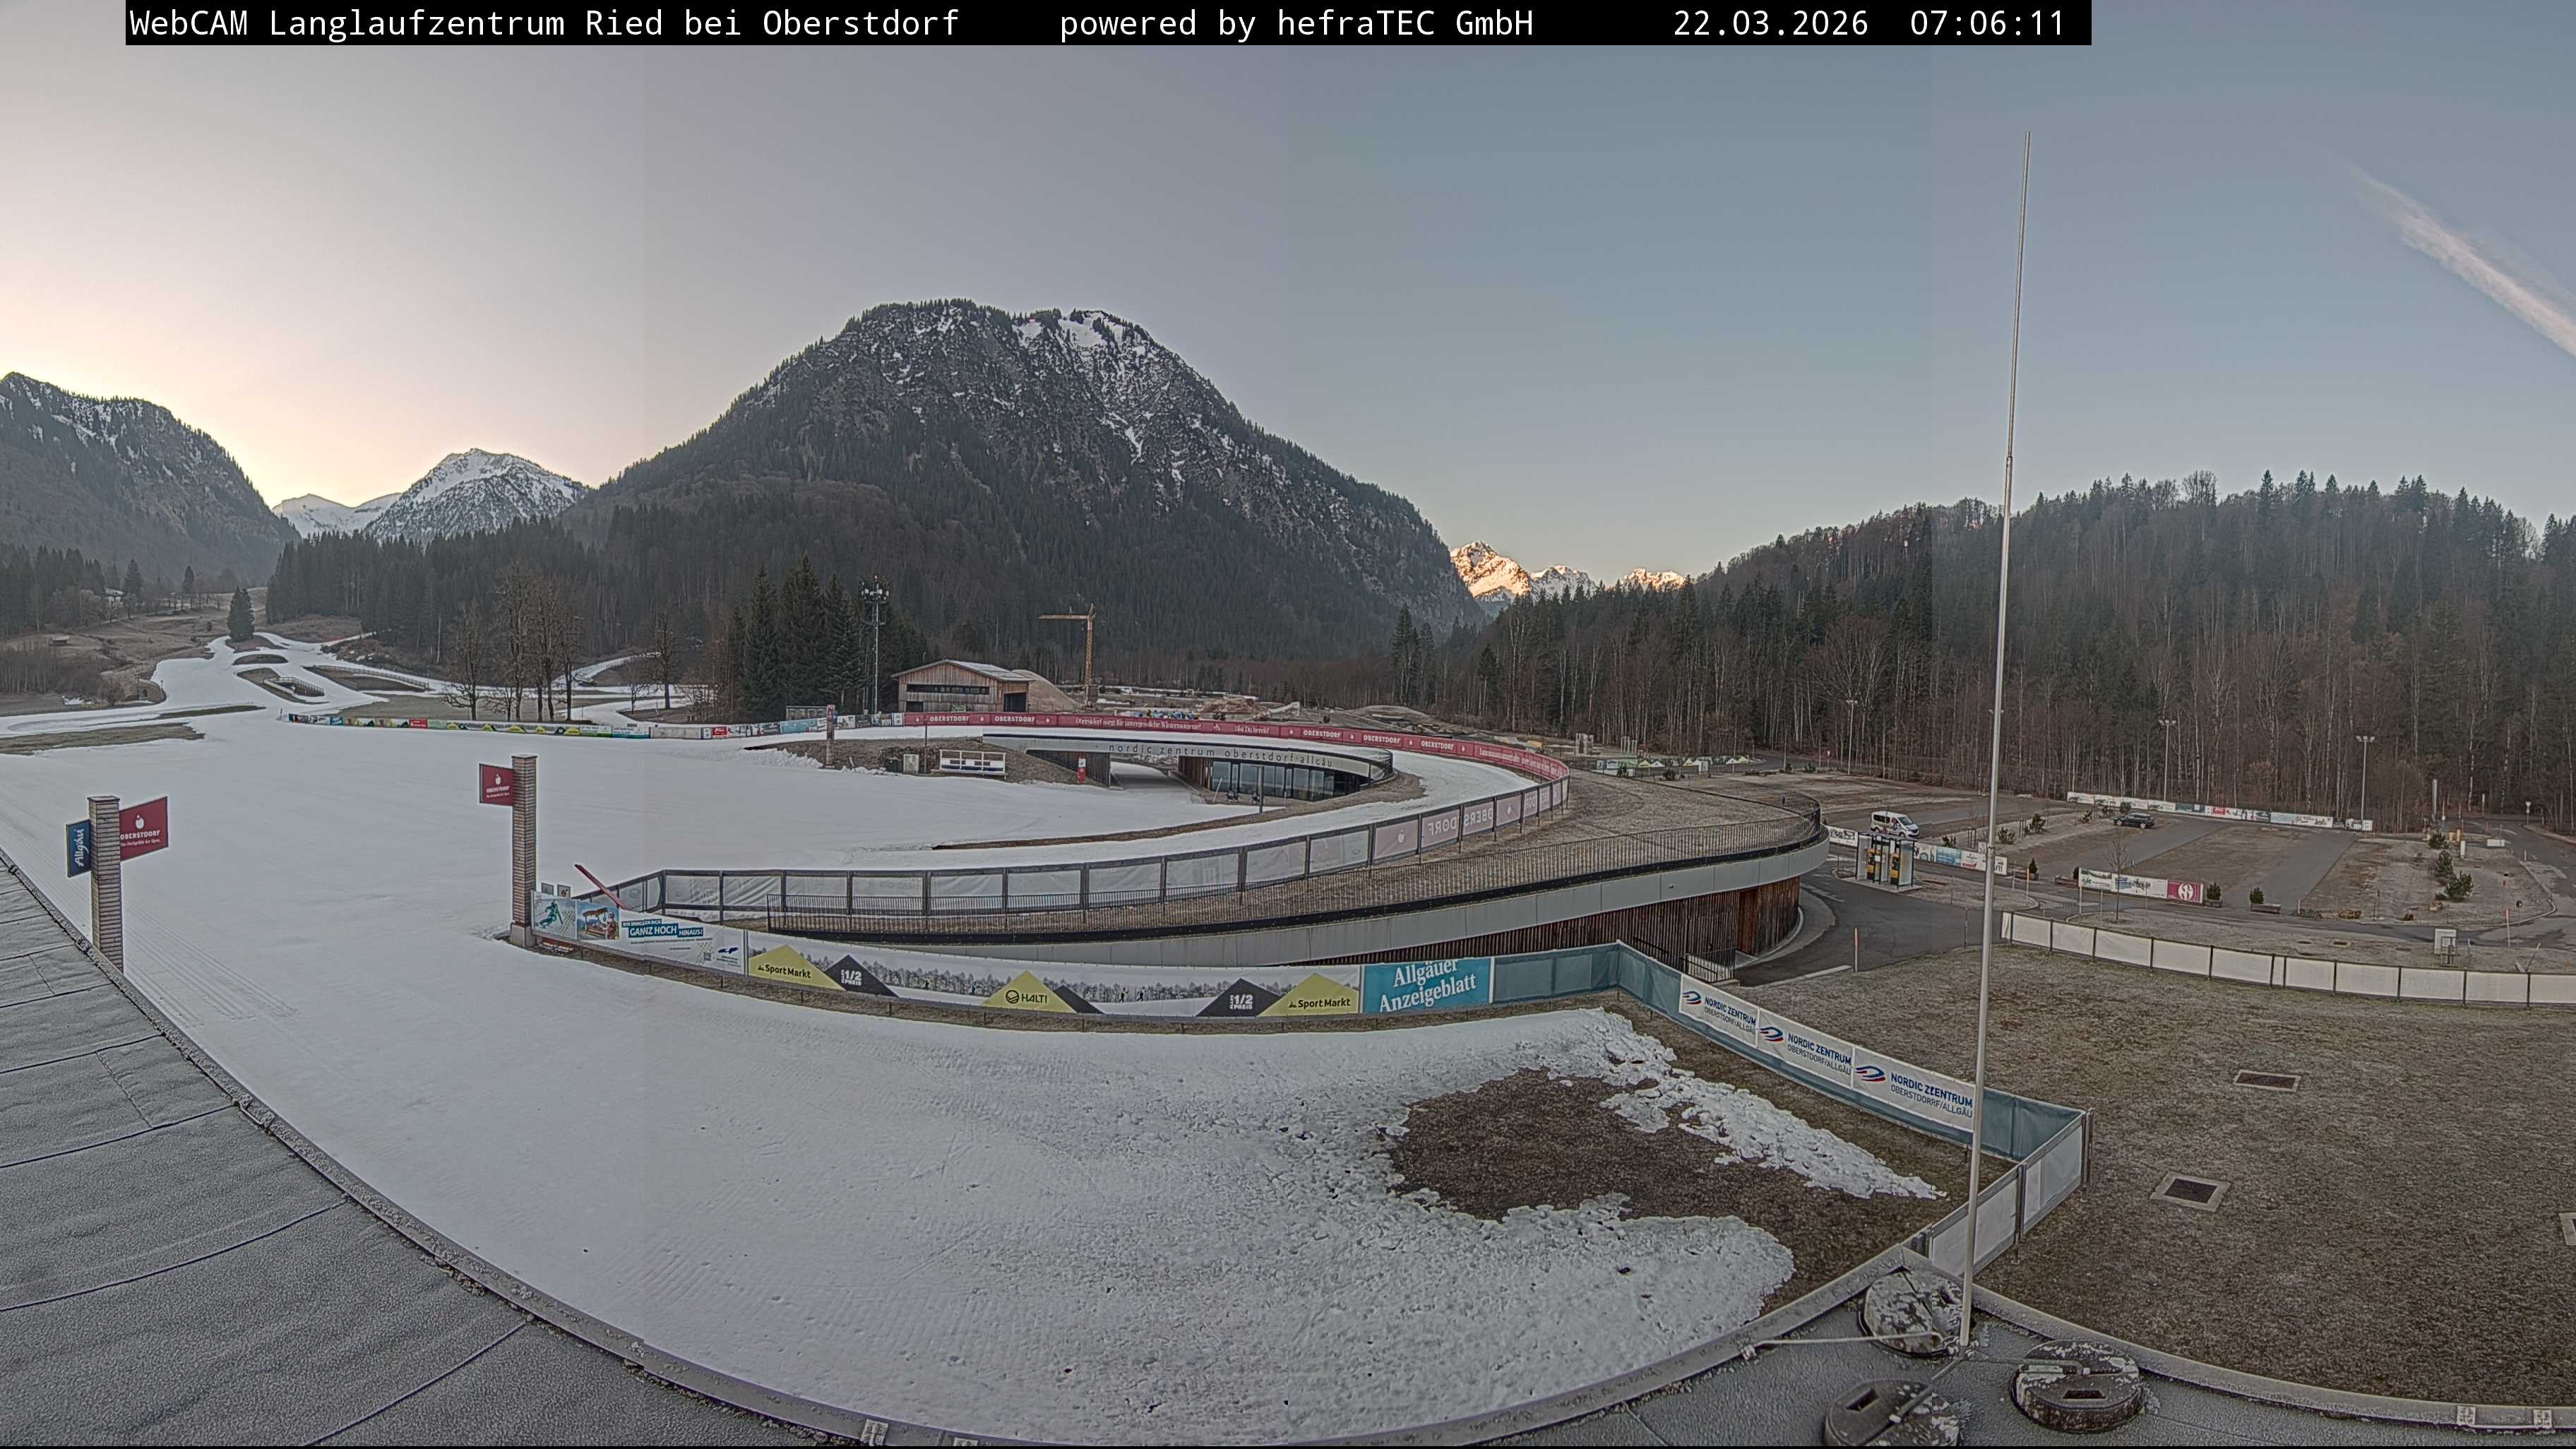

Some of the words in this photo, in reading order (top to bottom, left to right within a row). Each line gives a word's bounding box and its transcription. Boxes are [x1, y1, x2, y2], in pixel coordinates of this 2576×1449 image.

[1303, 729, 1342, 739] OBERSTDORF
[1363, 734, 1401, 744] OBERSTDORF
[1109, 744, 1152, 753] nordic
[1159, 746, 1215, 756] zentrum
[1421, 740, 1455, 750] OBERSTDORF
[120, 830, 161, 840] OBERSTDORF
[73, 828, 90, 867] Allgäu
[654, 925, 677, 934] HOCH
[845, 970, 861, 981] 1/2
[1393, 960, 1458, 988] Allgäuer
[1021, 993, 1048, 1003] HALTI
[1379, 973, 1477, 1013] Anzeigeblatt
[1234, 994, 1253, 1004] 1/2
[1705, 996, 1727, 1013] NORDIC
[1728, 1006, 1757, 1026] ZENTRUM
[1787, 1032, 1815, 1051] NORDIC
[1815, 1044, 1852, 1066] ZENTRUM
[1787, 1044, 1852, 1076] OBERSTDORF/ALLGÄU
[1890, 1072, 1924, 1092] NORDIC
